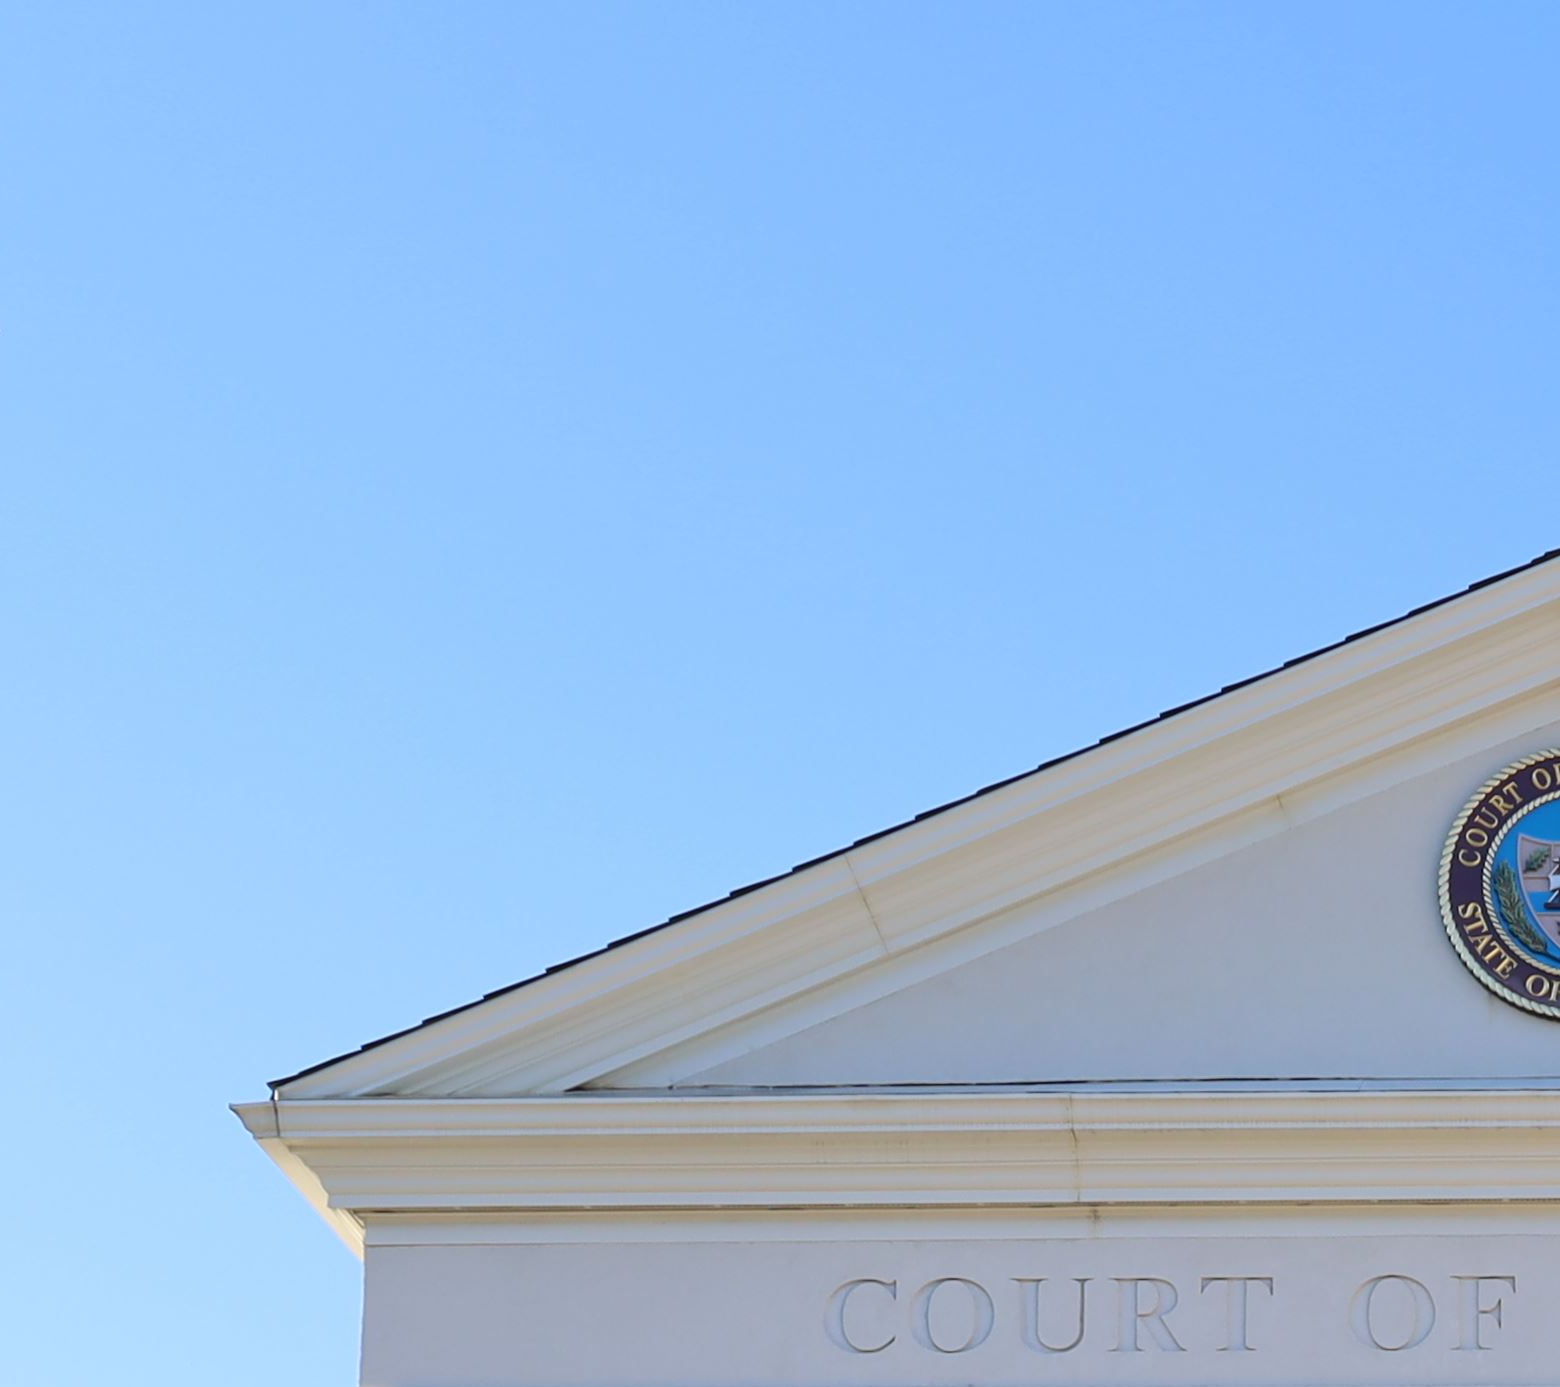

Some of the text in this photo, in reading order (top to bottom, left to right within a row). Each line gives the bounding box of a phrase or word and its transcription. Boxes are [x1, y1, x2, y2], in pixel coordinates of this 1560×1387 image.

[1458, 781, 1523, 867] COURT
[1458, 902, 1518, 979] STATE
[822, 1276, 1275, 1353] COURT
[1349, 1273, 1517, 1351] OF
